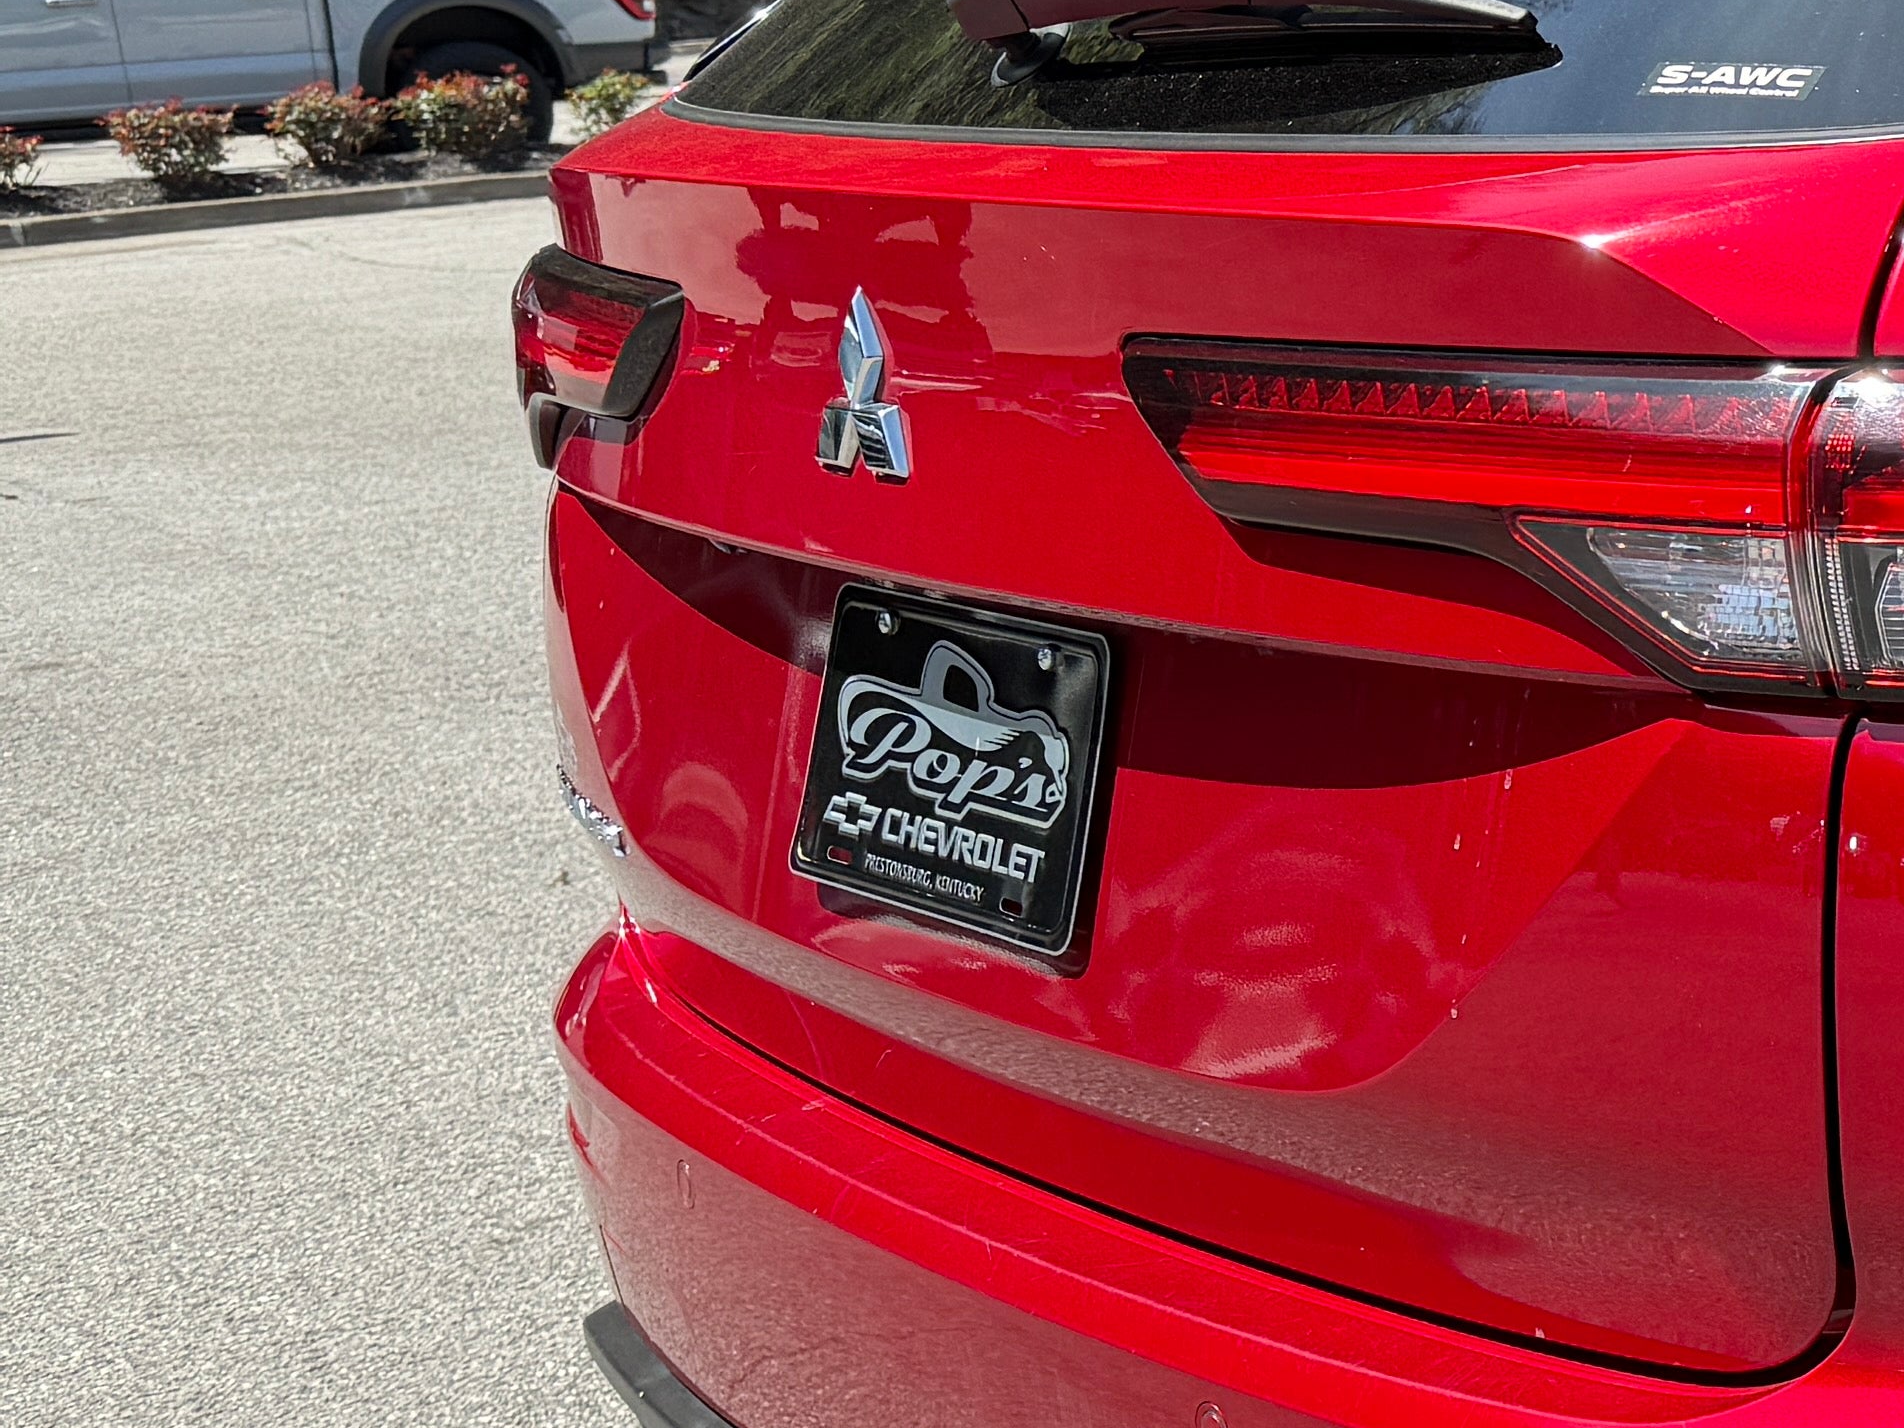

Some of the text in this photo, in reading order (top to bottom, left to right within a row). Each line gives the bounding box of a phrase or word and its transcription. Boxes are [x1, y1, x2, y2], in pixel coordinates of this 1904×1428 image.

[1656, 64, 1814, 88] S-AWC
[850, 706, 1052, 812] Pop's
[881, 808, 1045, 883] CHEVROLET
